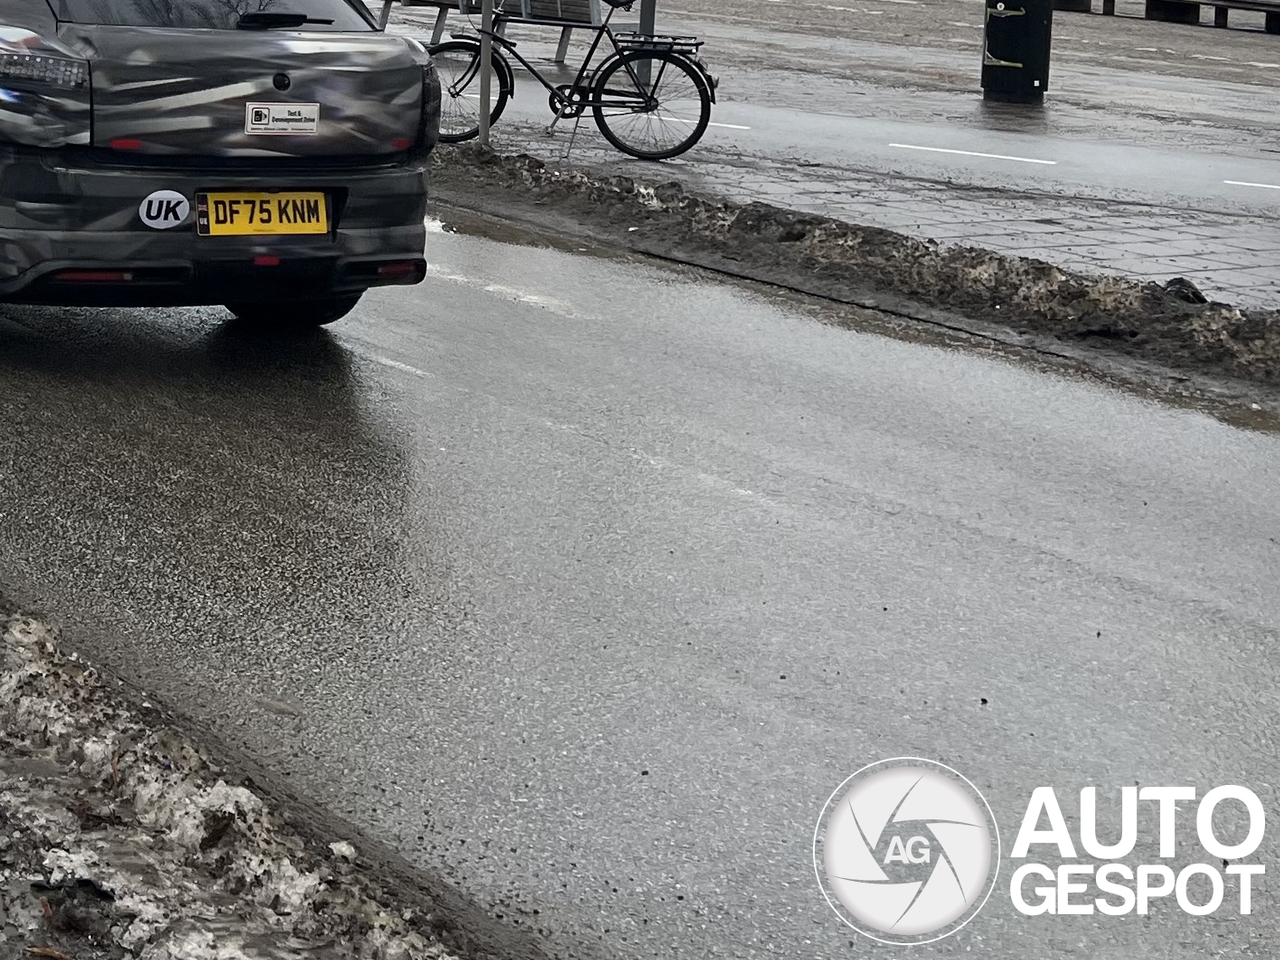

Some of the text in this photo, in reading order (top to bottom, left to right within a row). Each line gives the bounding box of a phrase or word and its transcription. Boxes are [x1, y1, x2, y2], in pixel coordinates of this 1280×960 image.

[145, 199, 185, 221] UK
[213, 199, 320, 225] DF75 KNM
